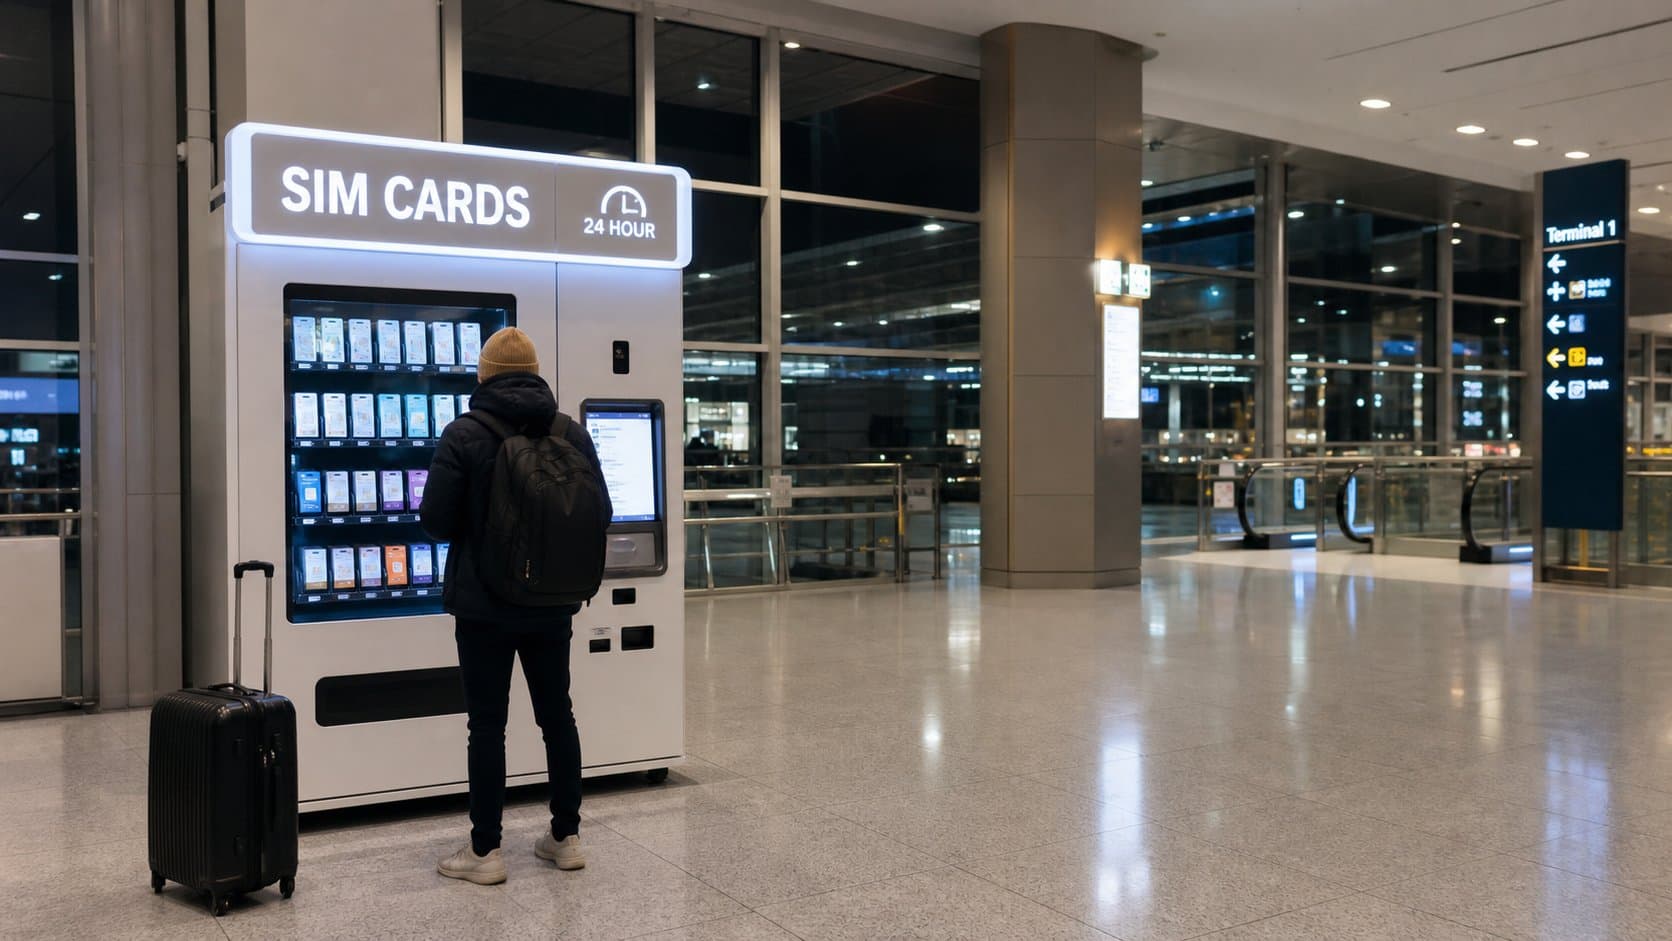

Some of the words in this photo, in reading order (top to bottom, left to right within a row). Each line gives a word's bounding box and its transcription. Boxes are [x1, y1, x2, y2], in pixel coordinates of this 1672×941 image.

[281, 165, 368, 217] SIM
[384, 175, 531, 229] CARDS
[584, 216, 606, 234] 24
[609, 219, 656, 239] HOUR
[1546, 220, 1605, 244] Terminal
[1607, 219, 1617, 237] 1
